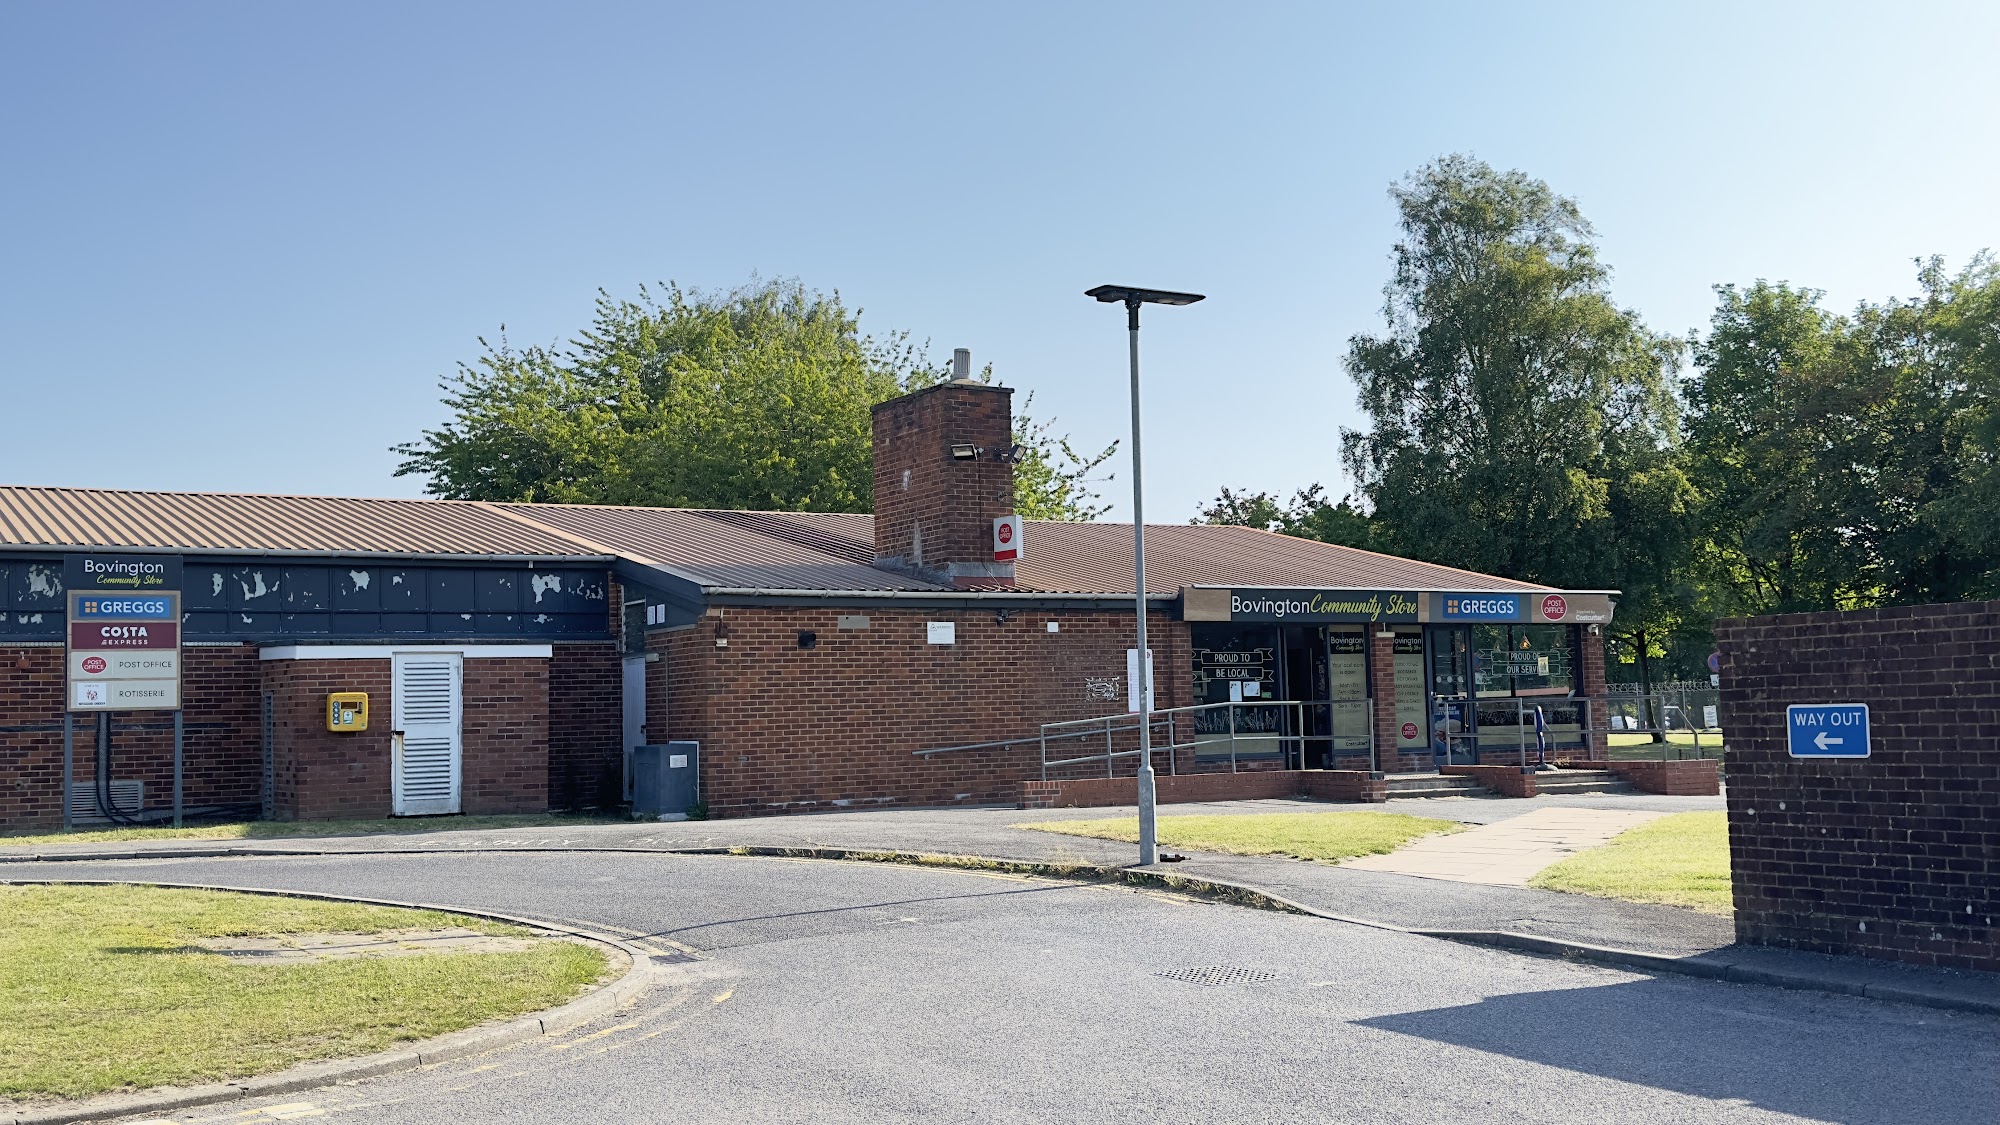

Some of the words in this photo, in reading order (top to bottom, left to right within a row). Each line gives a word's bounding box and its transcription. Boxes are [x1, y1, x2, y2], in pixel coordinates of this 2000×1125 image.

[84, 559, 164, 576] Bovington
[96, 574, 141, 588] Community
[143, 575, 163, 585] Store
[101, 601, 164, 613] GREGGS
[1231, 595, 1310, 618] Bovington
[1310, 593, 1382, 622] Community
[1385, 594, 1417, 615] Store
[1461, 600, 1514, 614] GREGGS
[1544, 606, 1565, 614] OFFICE
[101, 627, 148, 638] COSTA
[1331, 636, 1364, 645] Bovington
[1214, 653, 1239, 662] PROUD
[1240, 653, 1251, 662] TO
[1510, 652, 1531, 661] PROUD
[1215, 668, 1226, 677] BE
[1227, 668, 1250, 678] LOCAL
[1506, 665, 1520, 674] OUR
[119, 690, 165, 698] ROTISSERIE
[1794, 712, 1825, 726] WAY
[1830, 712, 1861, 726] OUT
